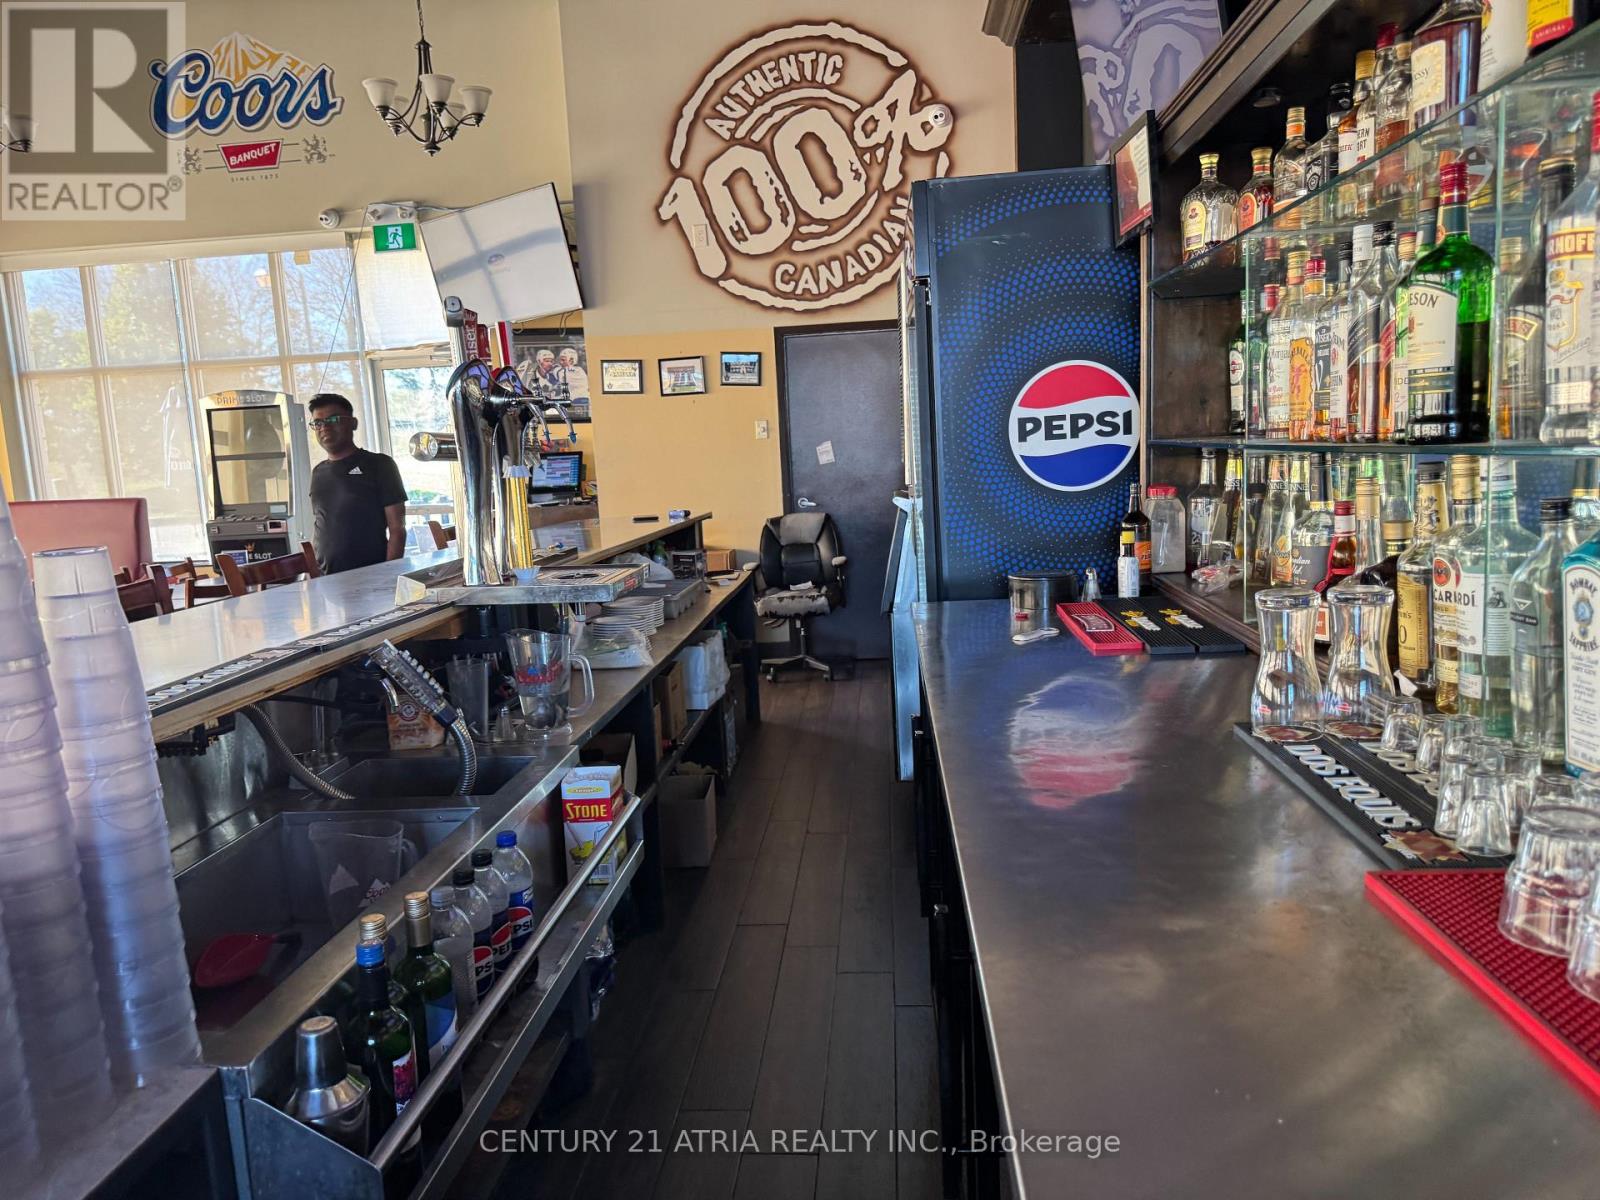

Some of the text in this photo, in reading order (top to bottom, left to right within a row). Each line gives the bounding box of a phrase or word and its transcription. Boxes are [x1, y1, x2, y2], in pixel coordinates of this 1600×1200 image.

[148, 49, 344, 139] Coors
[704, 50, 844, 141] AUTHENTIC
[229, 142, 277, 166] BANQUET
[658, 68, 952, 279] 100%
[774, 195, 910, 295] CANADIAN
[1408, 291, 1440, 309] ESON
[246, 394, 267, 402] SLOT
[1017, 409, 1133, 443] PEPSI
[254, 552, 272, 560] SLOT
[565, 802, 608, 820] STONE
[512, 919, 533, 935] PSI
